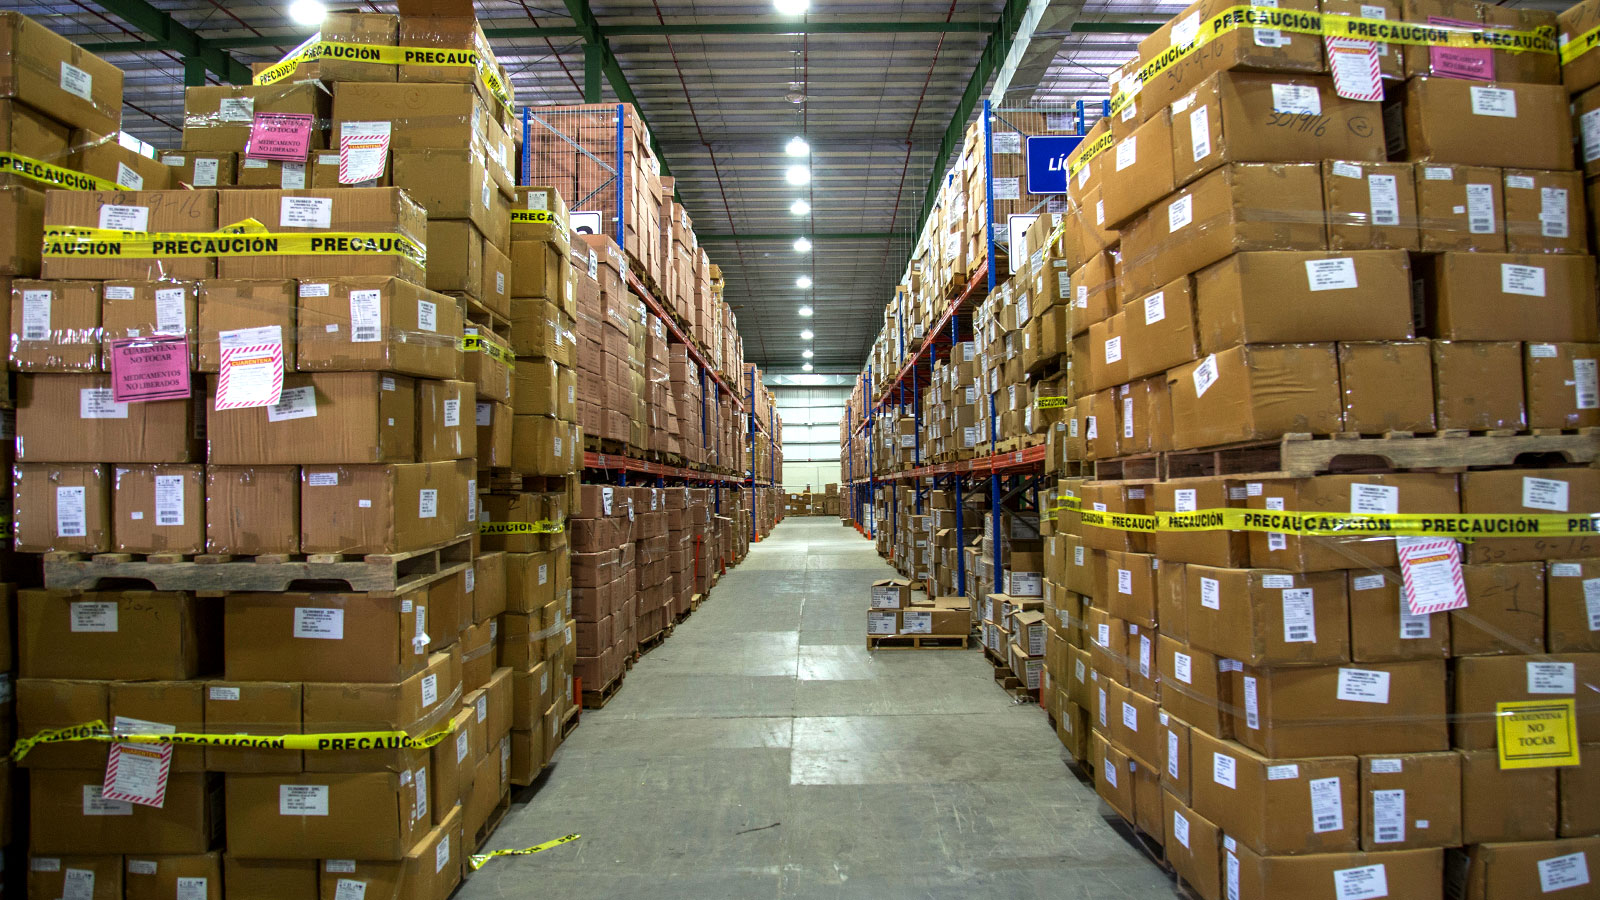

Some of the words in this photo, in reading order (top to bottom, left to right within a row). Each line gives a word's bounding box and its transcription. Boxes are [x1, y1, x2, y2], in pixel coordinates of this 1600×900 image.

[1214, 10, 1321, 33] PRECAUCIÓN
[1348, 21, 1449, 42] PRECAUCIÓN
[0, 156, 97, 191] PRECAUCIÓN
[152, 237, 278, 255] PRECAUCIÓN
[311, 238, 404, 252] PRECAUC
[123, 344, 177, 356] CUARENTENA
[130, 356, 143, 364] NO
[143, 353, 172, 362] TOCAR
[123, 369, 181, 382] MEDICAMENTOS
[139, 379, 180, 389] LIBERADOS
[1169, 512, 1223, 528] PRECAUCIÓN
[1422, 517, 1539, 533] PRECAUCIÓN
[1527, 723, 1545, 733] NO
[1518, 736, 1556, 746] TOCAR
